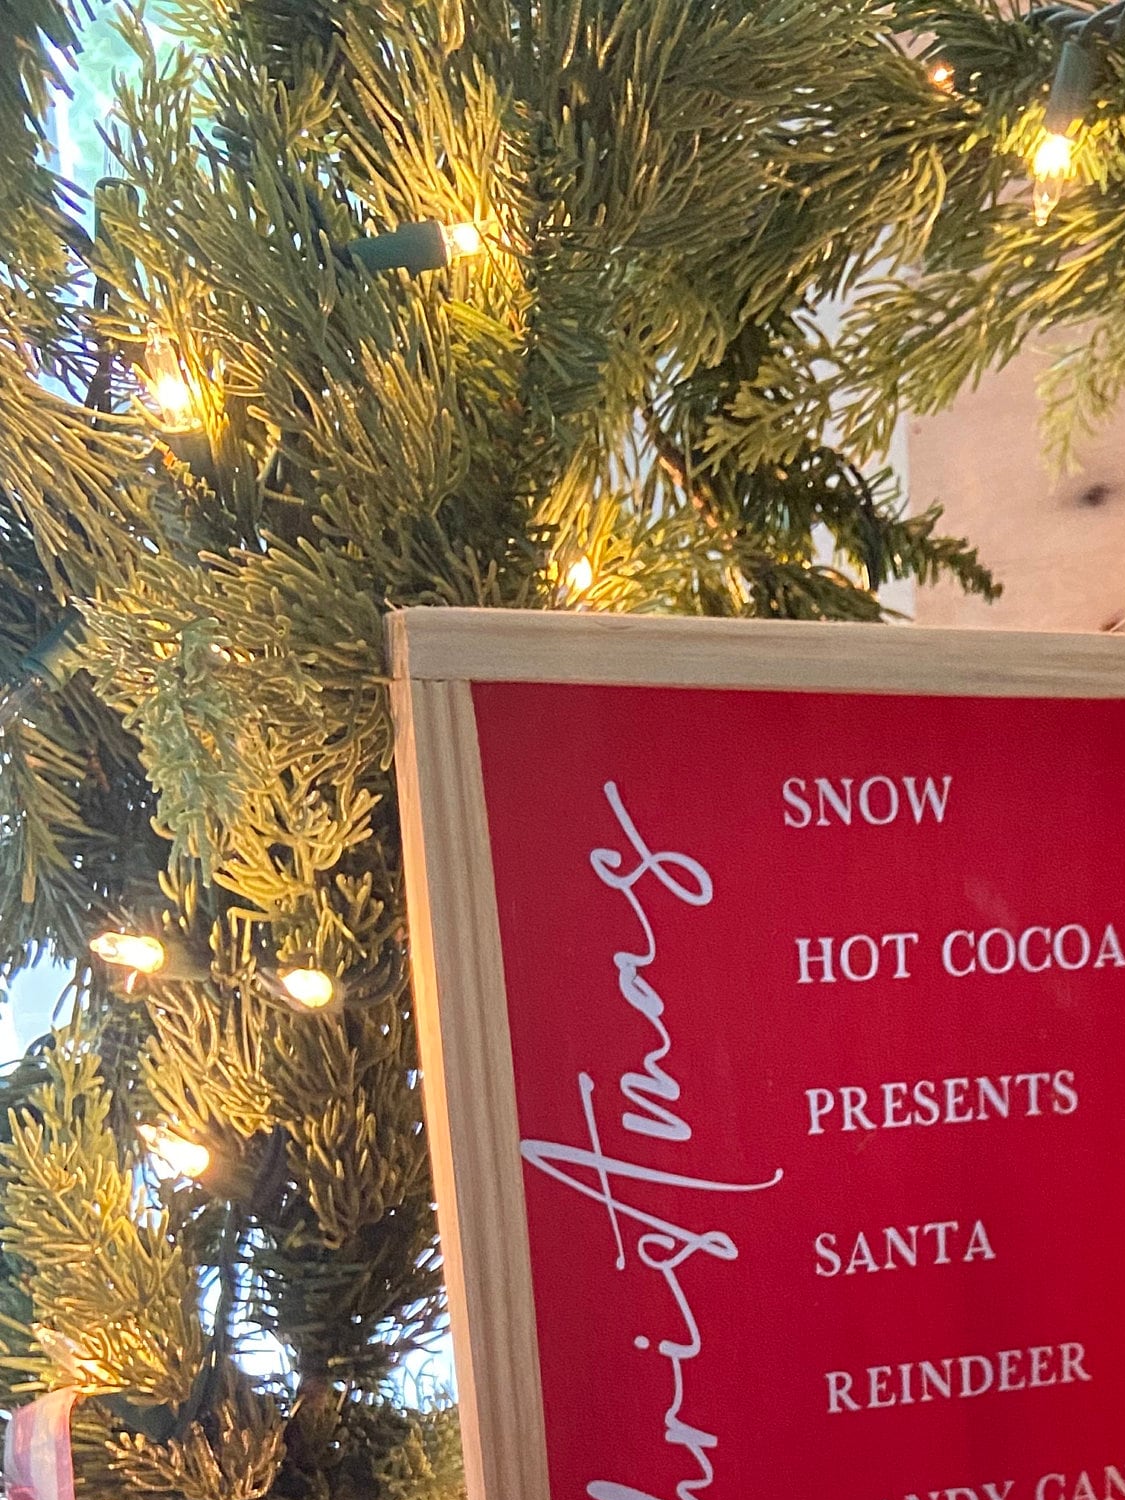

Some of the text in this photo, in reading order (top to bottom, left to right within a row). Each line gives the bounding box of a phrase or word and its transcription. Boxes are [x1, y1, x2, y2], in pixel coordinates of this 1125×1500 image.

[781, 775, 954, 830] SNOW
[793, 931, 920, 985] HOT
[803, 1068, 1080, 1137] PRESENTS
[813, 1218, 997, 1278] SANTA
[824, 1341, 1092, 1414] REINDEER
